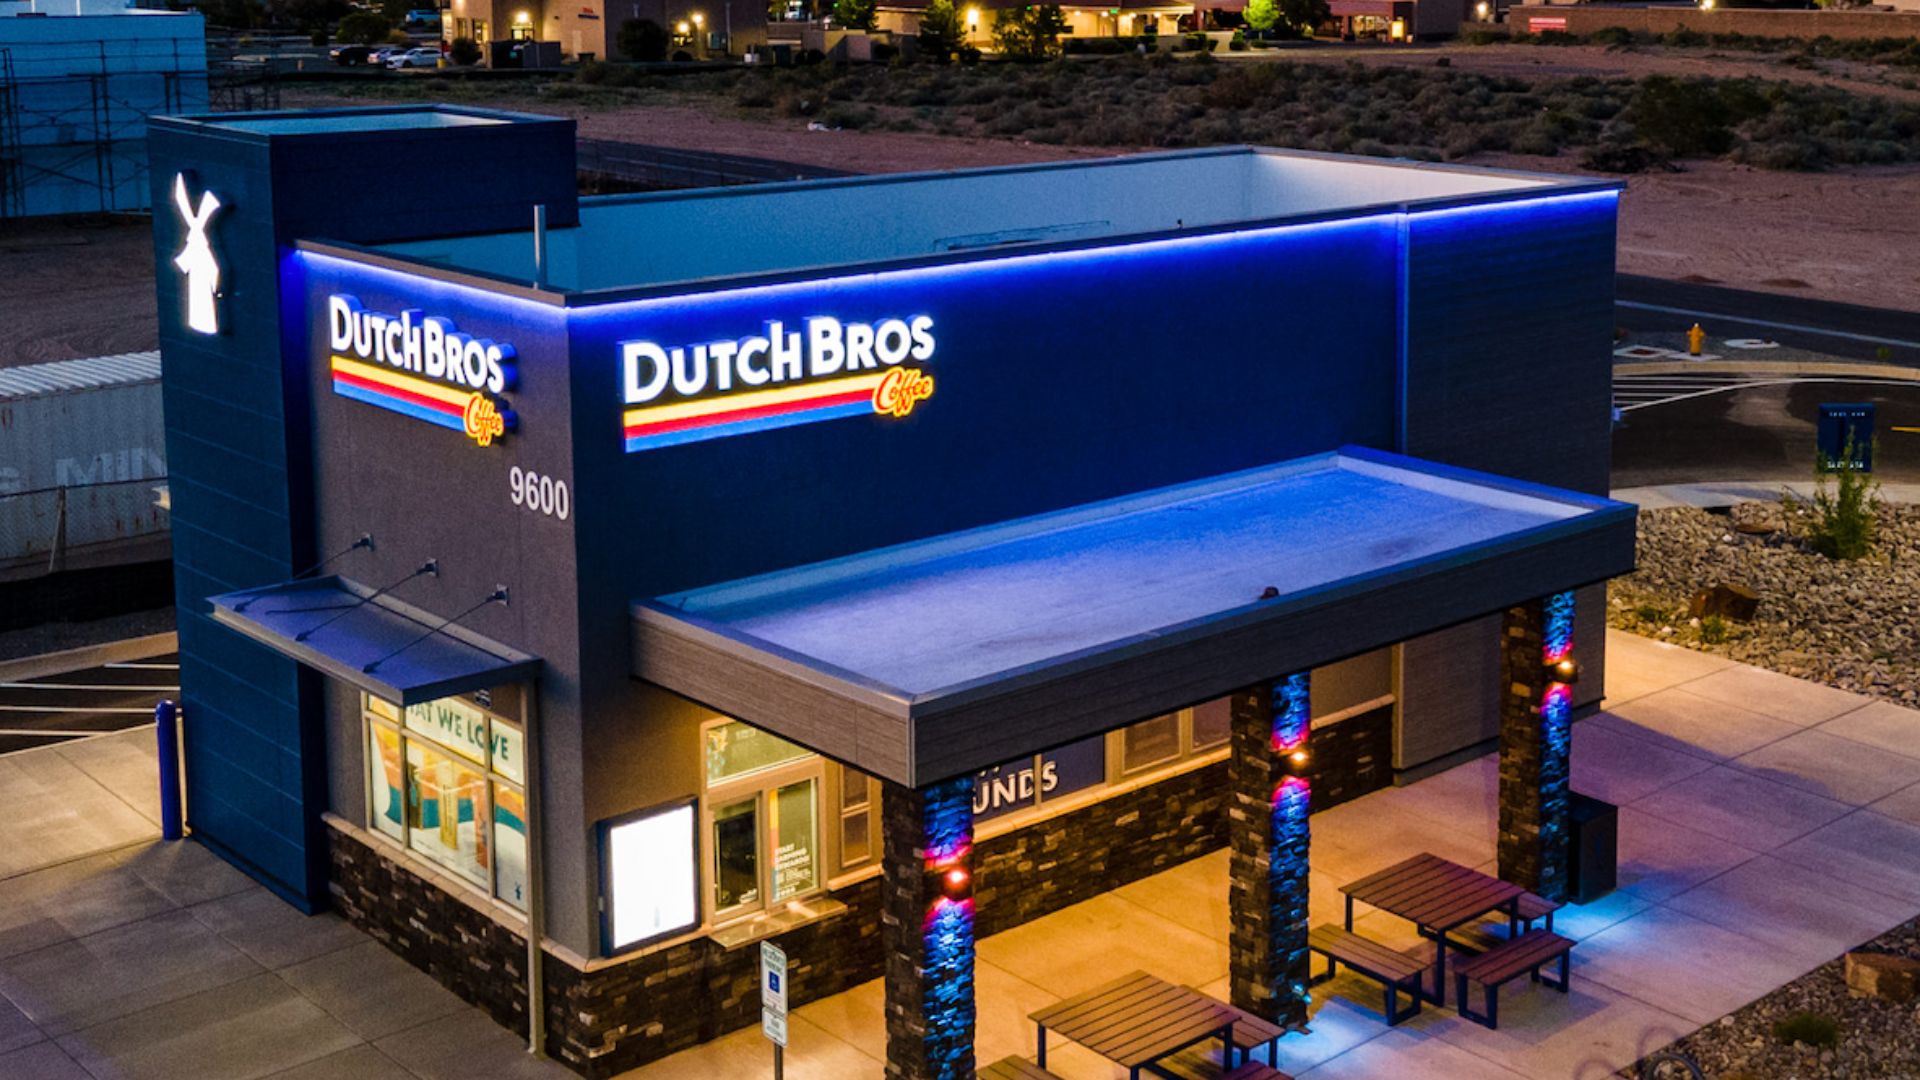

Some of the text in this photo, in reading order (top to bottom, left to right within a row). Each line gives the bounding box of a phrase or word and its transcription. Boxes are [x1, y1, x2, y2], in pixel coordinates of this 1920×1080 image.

[329, 295, 505, 394] DUTCH BROS
[623, 315, 936, 404] DUTCH BROS
[464, 391, 505, 447] Coffee
[872, 366, 935, 418] Coffee
[510, 466, 569, 520] 9600
[410, 700, 433, 724] AT
[437, 706, 462, 738] WE
